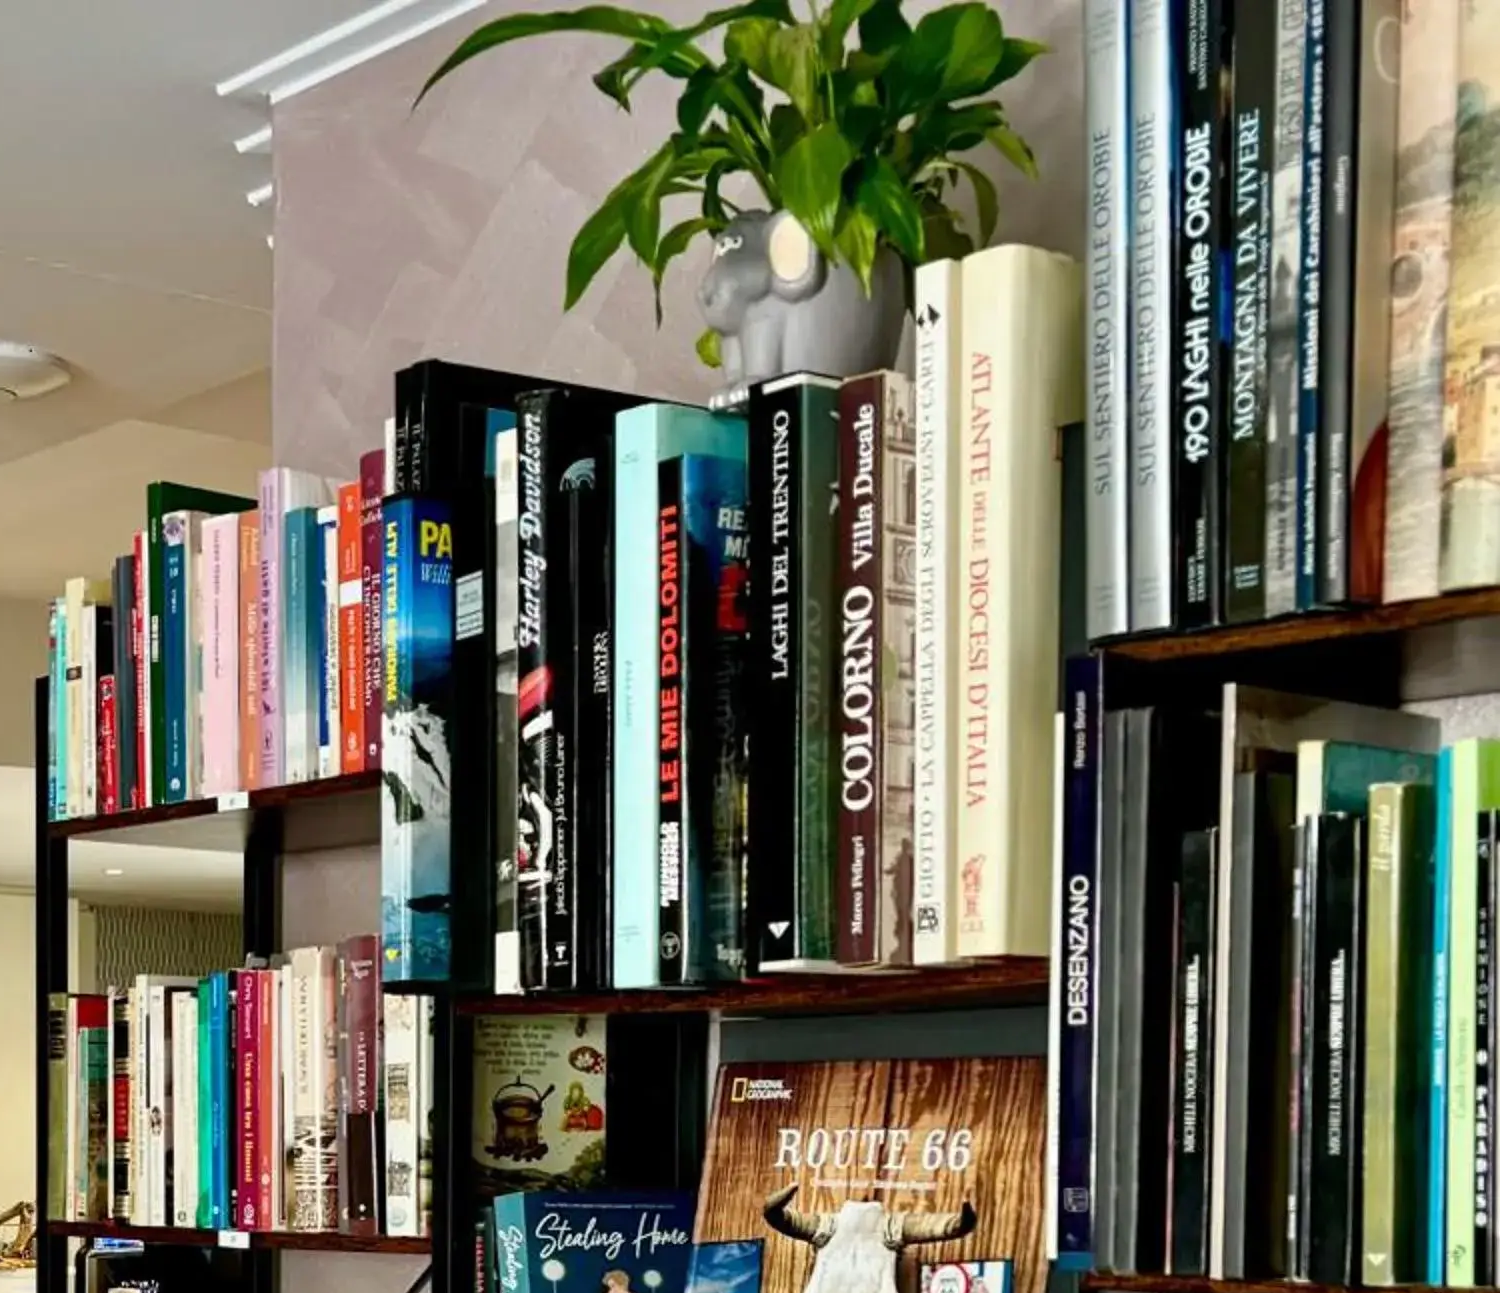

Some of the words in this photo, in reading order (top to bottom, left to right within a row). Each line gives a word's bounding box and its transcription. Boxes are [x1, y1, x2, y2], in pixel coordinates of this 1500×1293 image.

[1092, 126, 1112, 230] OROBIE
[1135, 111, 1157, 216] OROBIE
[1184, 121, 1212, 238] OROBIE
[1237, 108, 1261, 216] VIVERE
[1092, 232, 1113, 310] DELLE
[1136, 219, 1157, 298] DELLE
[1184, 242, 1210, 312] nelle
[1237, 222, 1259, 264] DA
[1093, 317, 1113, 442] SENTIERO
[1136, 305, 1157, 430] SENTIERO
[1182, 316, 1211, 402] LAGHI
[1233, 274, 1258, 440] MONTAGNA
[851, 402, 875, 499] Ducale
[969, 351, 992, 487] ATLANTE
[1135, 437, 1157, 487] SUL
[1183, 406, 1211, 463] 190
[771, 408, 790, 544] TRENTINO
[1093, 447, 1113, 496] SUL
[851, 502, 874, 572] Villa
[971, 491, 987, 552] DELLE
[660, 504, 678, 677] DOLOMITI
[771, 544, 789, 596] DEL
[771, 601, 789, 680] LAGHI
[966, 557, 990, 674] DIOCESI
[661, 685, 678, 750] MIE
[842, 584, 874, 811] COLORNO
[920, 642, 935, 753] CAPPELLA
[661, 759, 679, 801] LE
[920, 762, 935, 788] LA
[966, 682, 989, 808] D'ITALIA
[919, 810, 935, 900] GIOTTO
[1067, 875, 1090, 1026] DESENZANO
[774, 1127, 910, 1170] ROUTE
[922, 1127, 973, 1172] 66
[500, 1225, 524, 1291] Stealing
[535, 1212, 626, 1261] Stealing
[631, 1211, 690, 1260] Home
